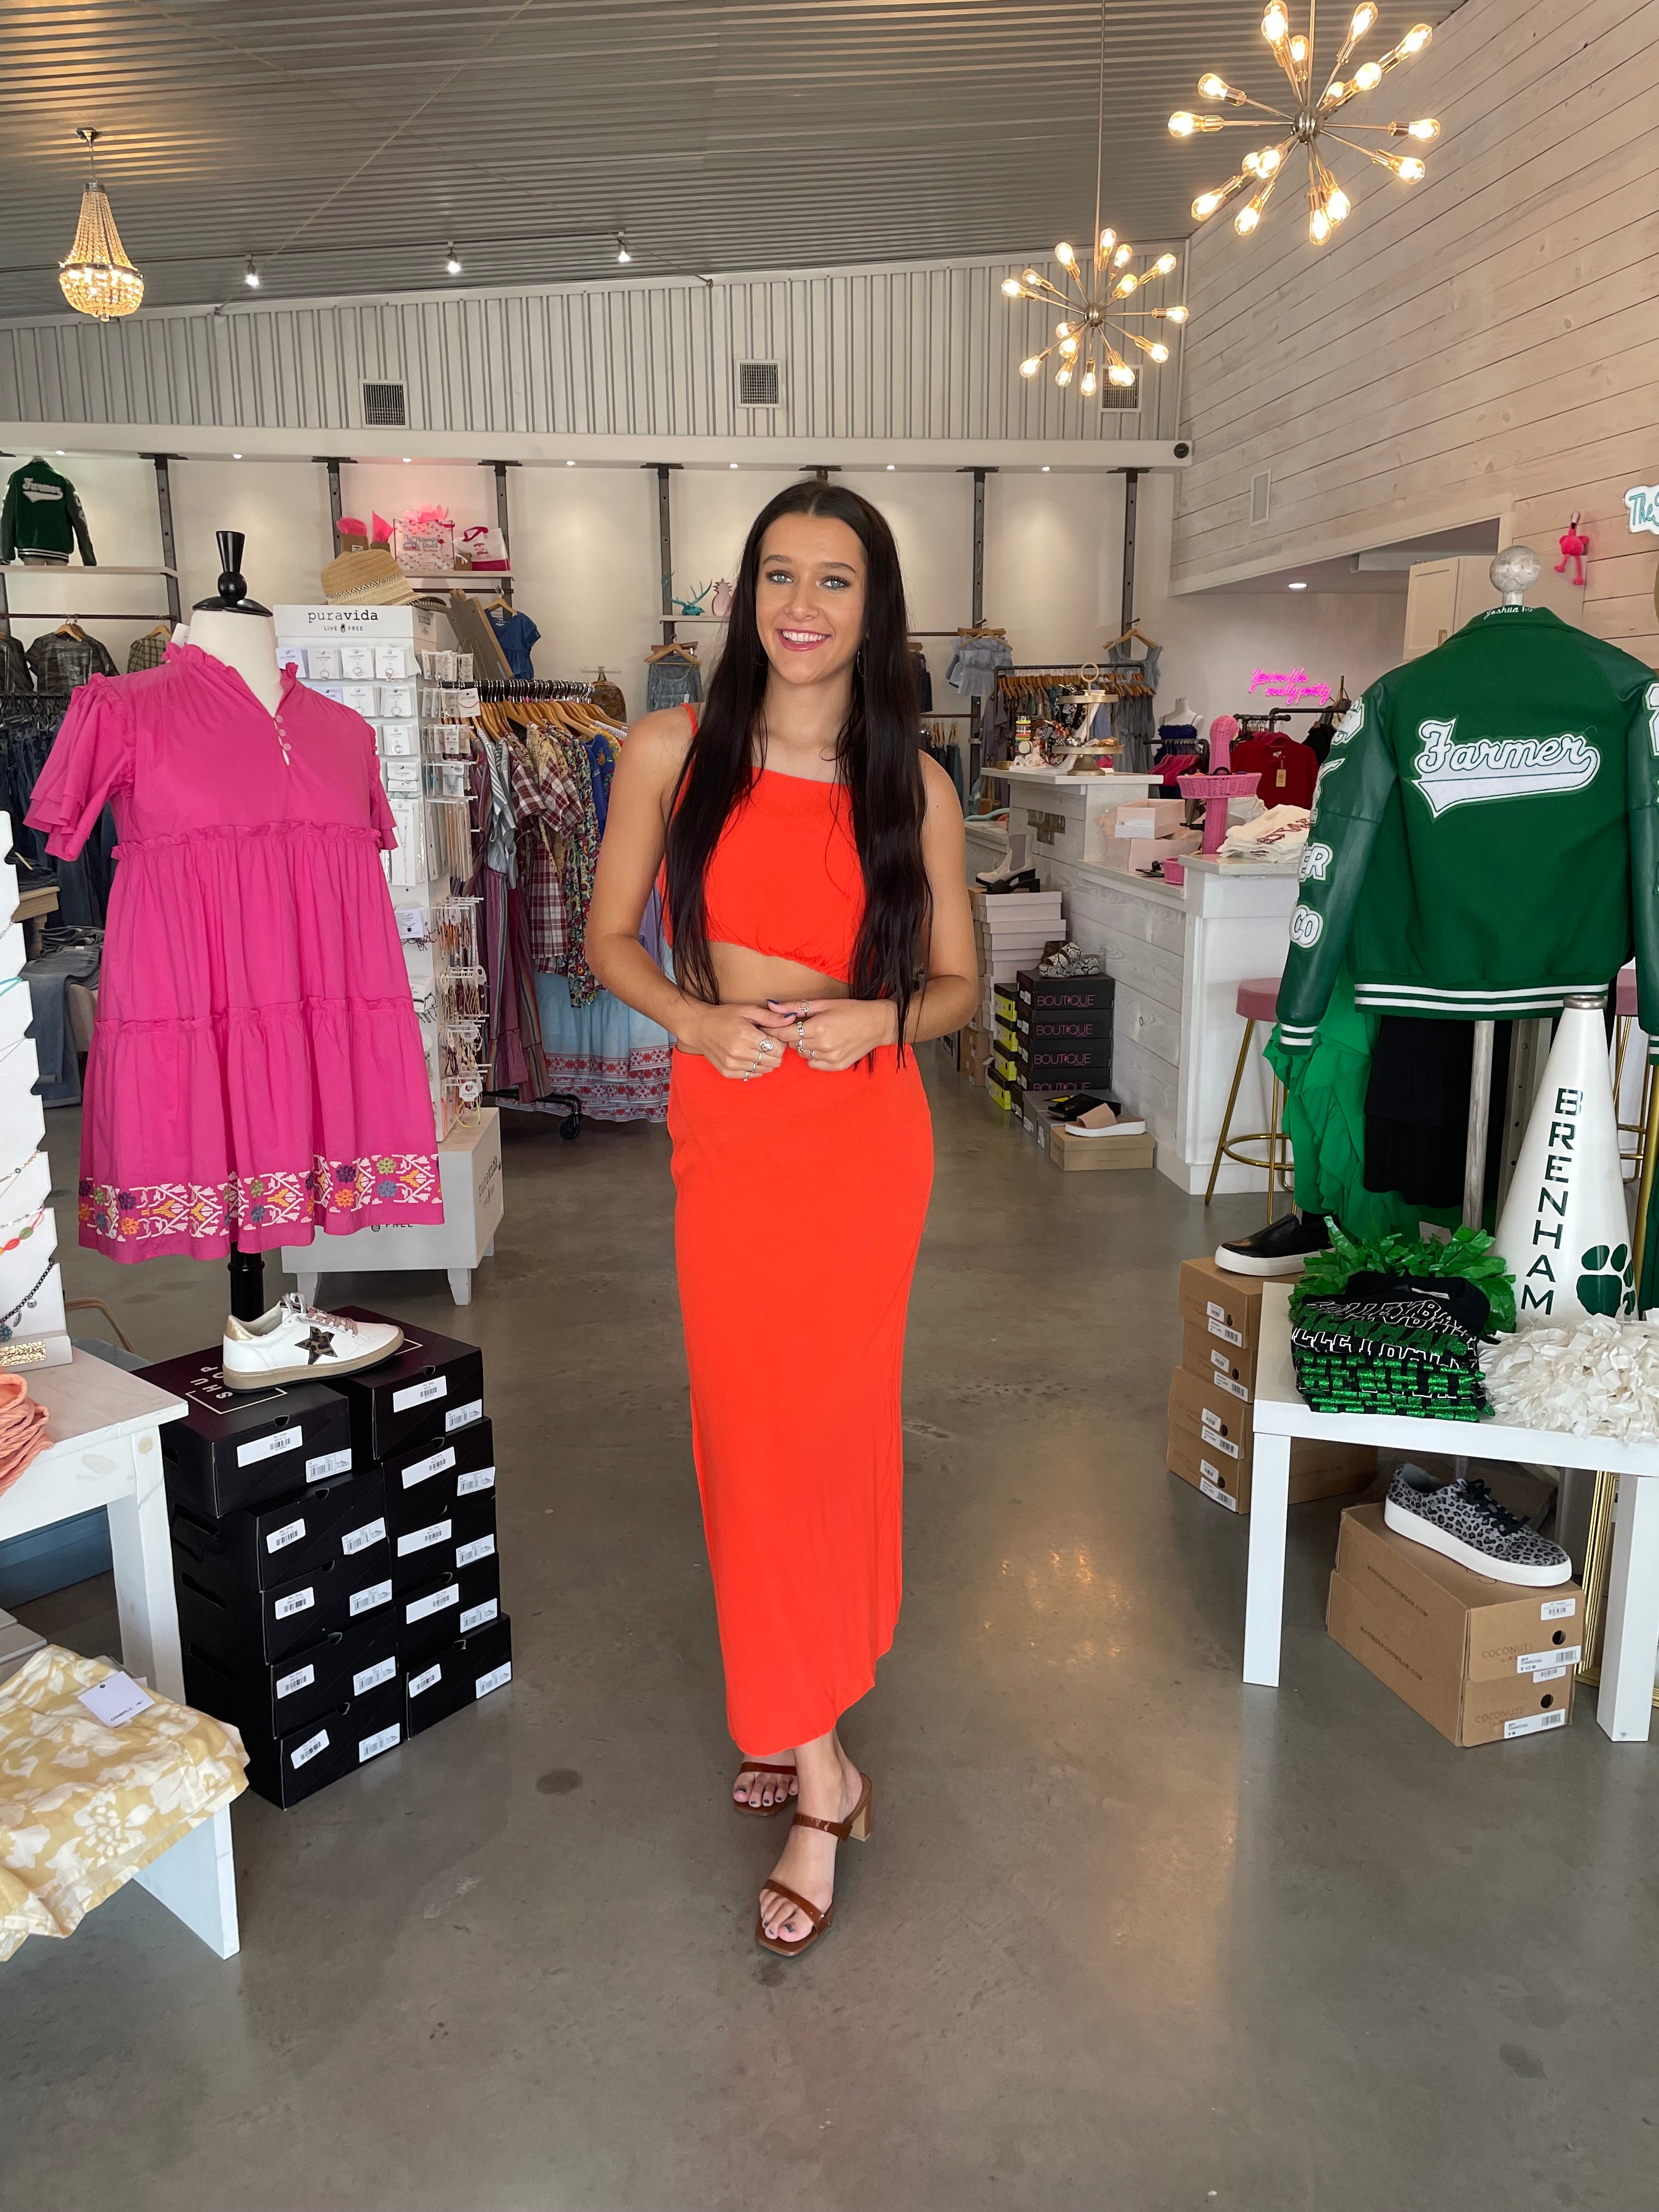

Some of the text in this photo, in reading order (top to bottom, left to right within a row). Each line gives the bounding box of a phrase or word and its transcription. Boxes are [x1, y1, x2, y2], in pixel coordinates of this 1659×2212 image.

[308, 610, 379, 623] puravida
[1265, 682, 1299, 706] really
[1414, 717, 1600, 776] Farmer
[1521, 1087, 1583, 1316] BRENHAM
[1482, 1643, 1534, 1658] COCONUTS
[1475, 1706, 1525, 1723] COCONUTS
